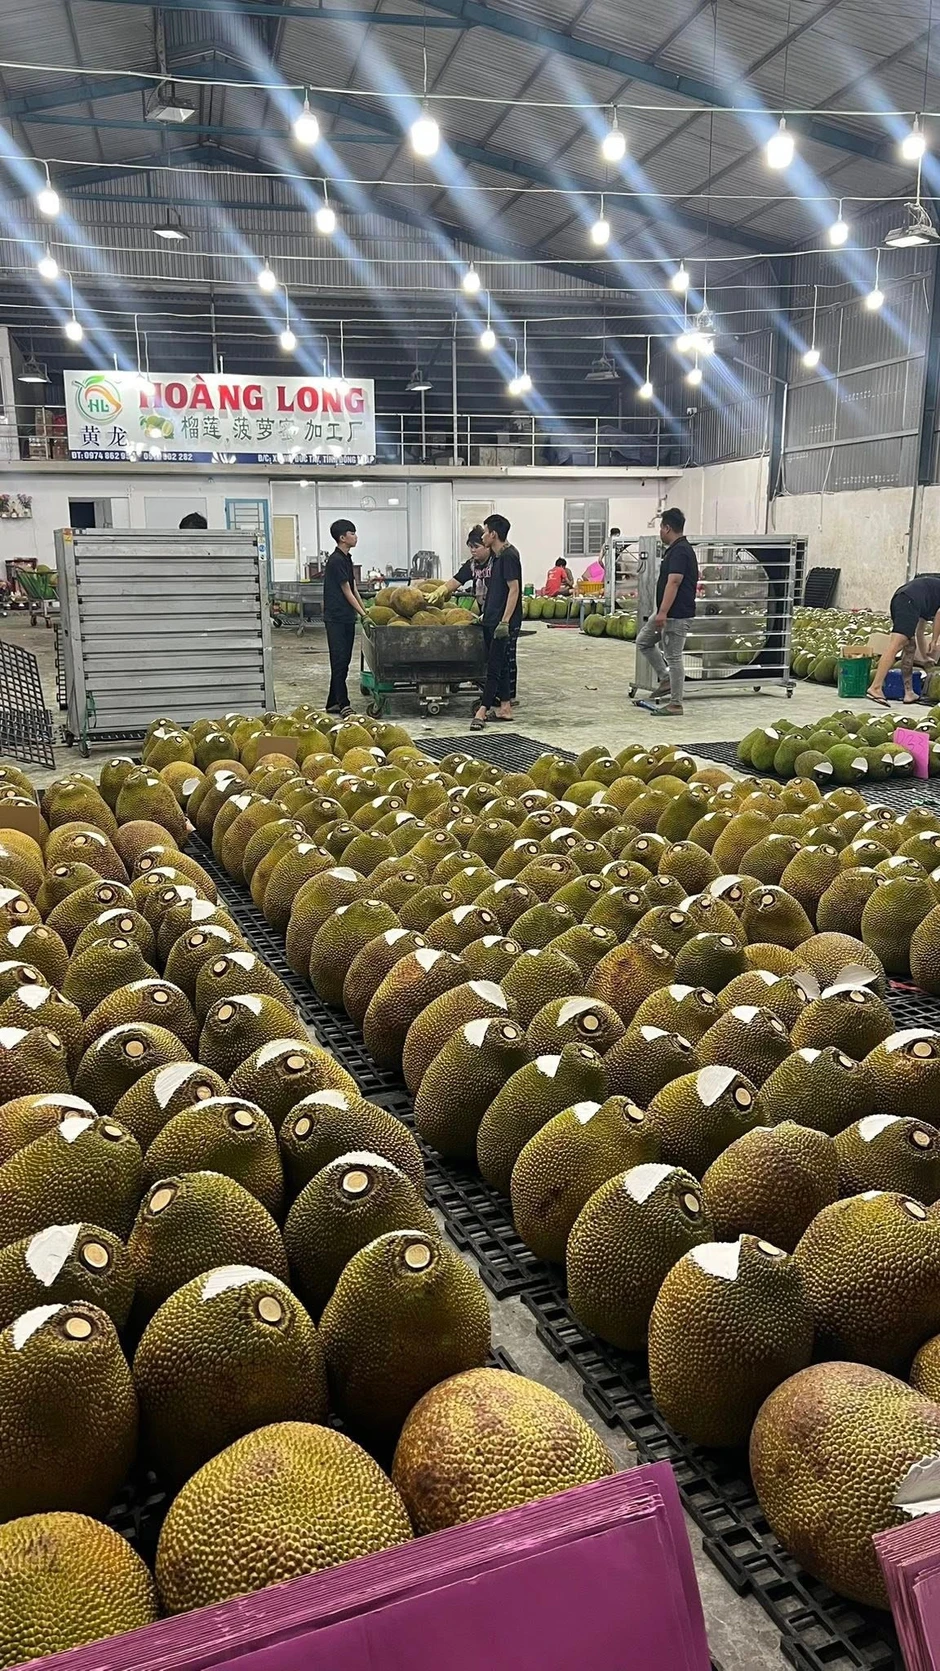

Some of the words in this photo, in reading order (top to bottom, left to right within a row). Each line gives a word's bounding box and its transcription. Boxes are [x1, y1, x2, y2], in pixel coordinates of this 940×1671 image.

[139, 373, 264, 410] HOÀNG
[277, 385, 365, 413] LONG
[88, 399, 110, 413] HL
[80, 425, 129, 447] 黄龙
[178, 453, 193, 461] 282
